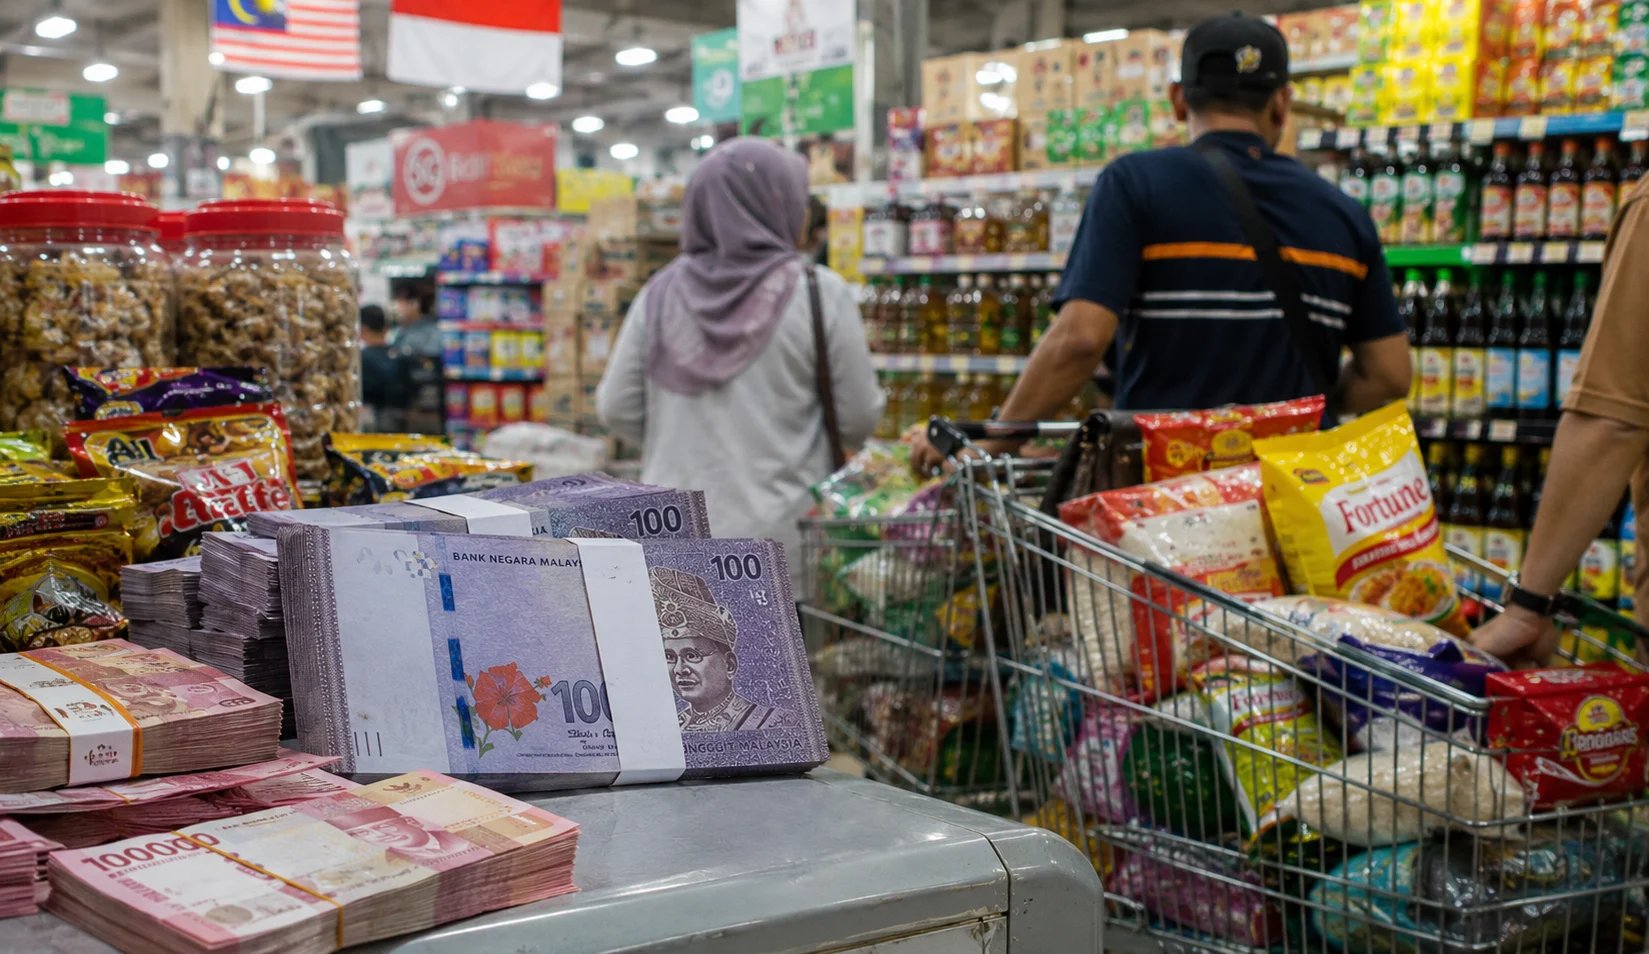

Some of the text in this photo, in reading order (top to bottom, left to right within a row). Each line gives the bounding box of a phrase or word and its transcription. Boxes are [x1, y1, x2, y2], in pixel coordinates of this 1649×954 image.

[1336, 477, 1429, 535] Fortune
[628, 505, 682, 537] 100
[453, 552, 486, 563] BANK
[490, 555, 537, 566] NEGARA
[710, 553, 762, 581] 100
[739, 738, 803, 751] MALAYSIA
